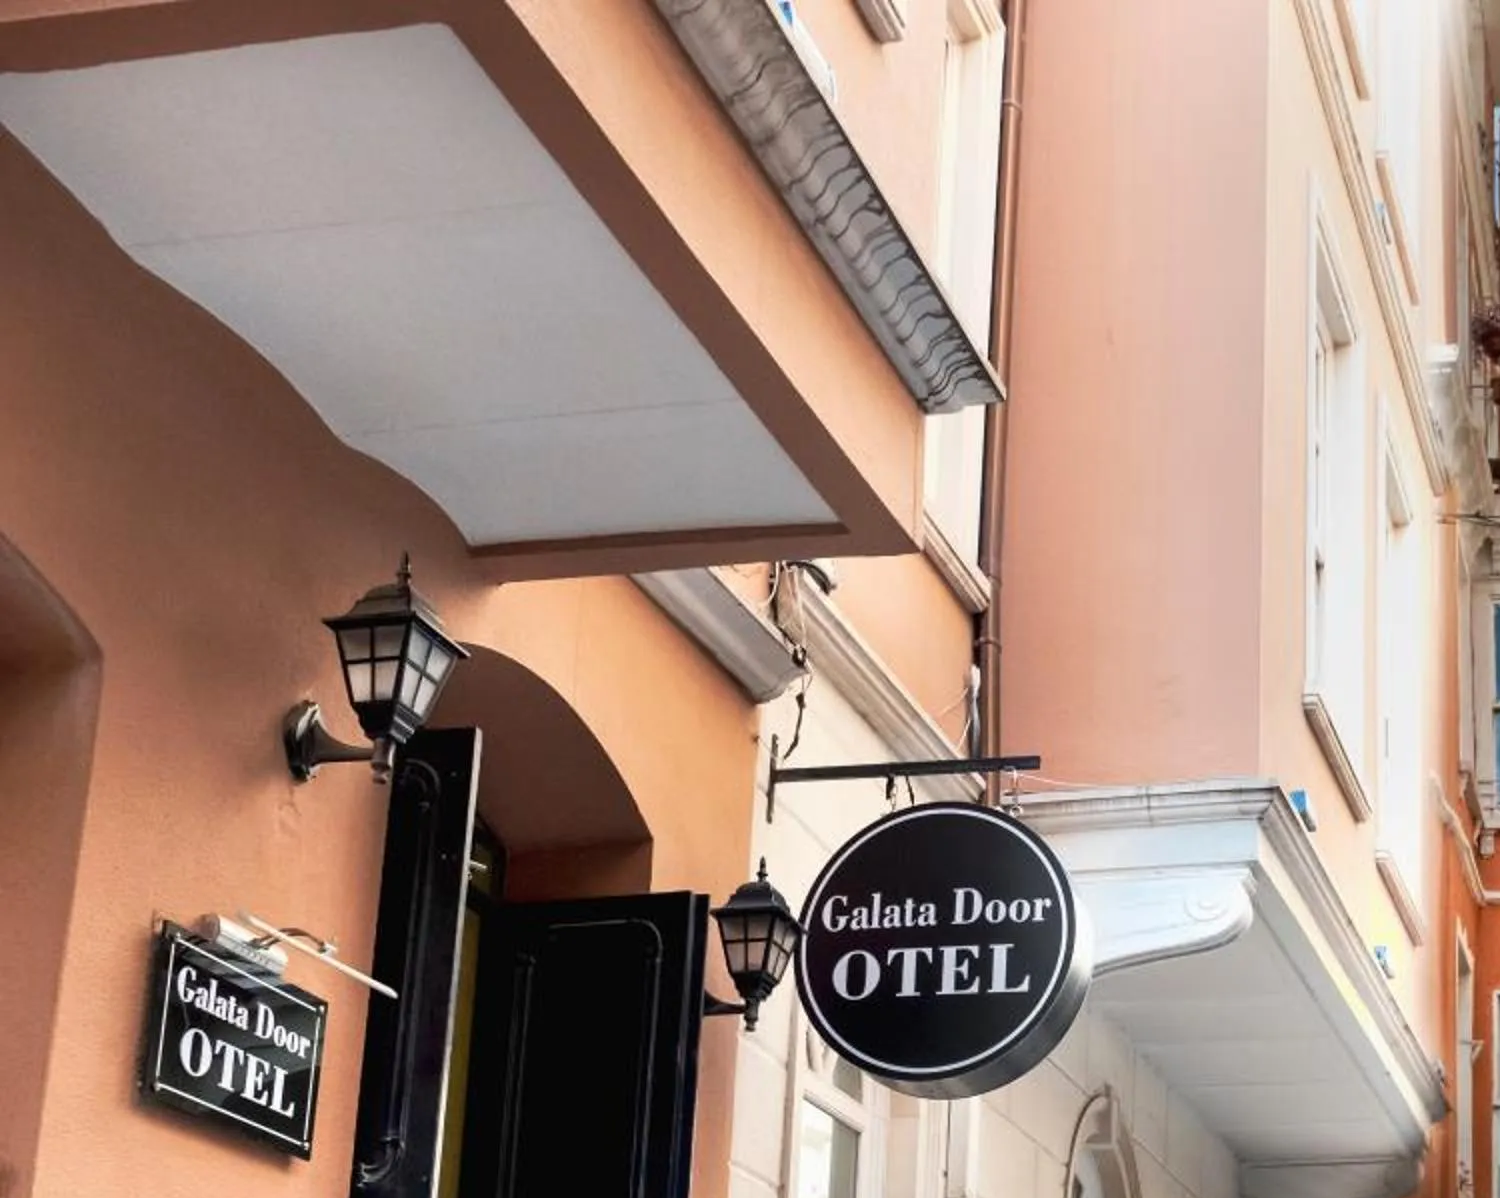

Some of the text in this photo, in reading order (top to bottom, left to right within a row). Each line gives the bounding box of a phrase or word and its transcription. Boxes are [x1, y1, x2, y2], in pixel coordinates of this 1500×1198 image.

[821, 887, 1052, 934] Galata Door
[832, 943, 1031, 1001] OTEL
[177, 965, 311, 1059] Galata Door
[179, 1027, 295, 1118] OTEL
